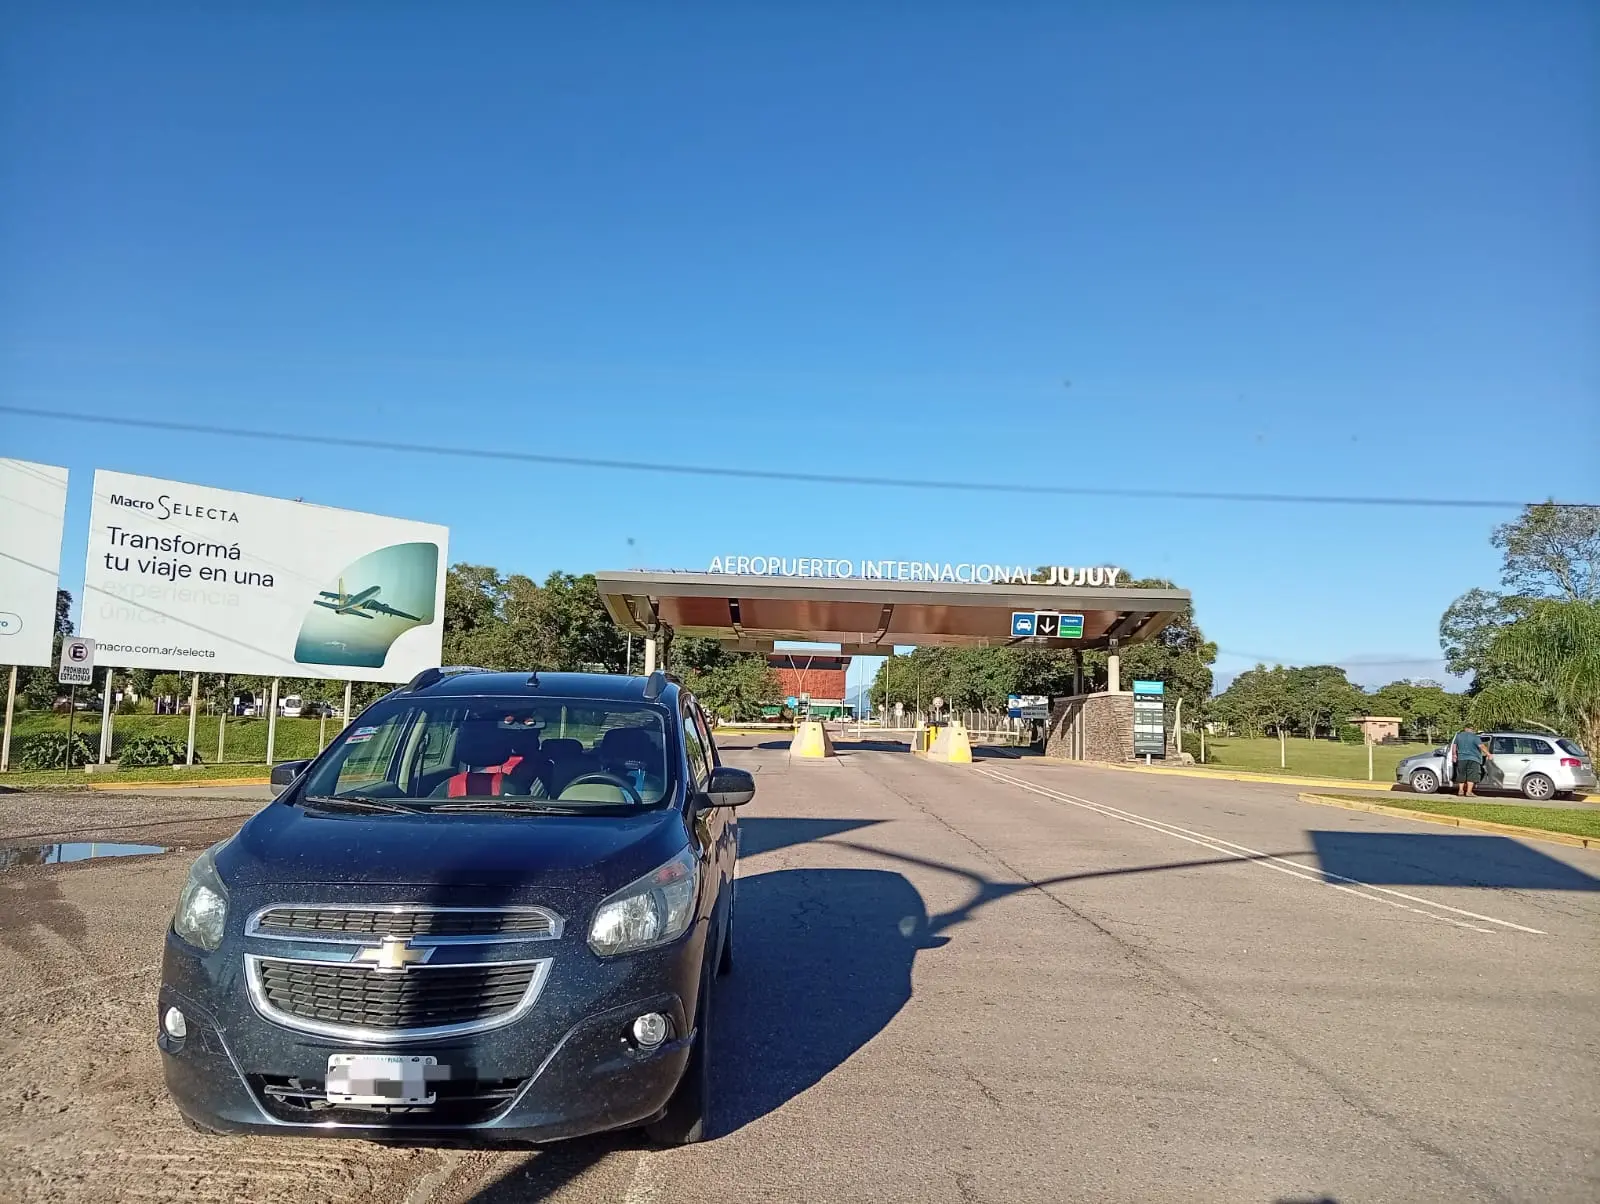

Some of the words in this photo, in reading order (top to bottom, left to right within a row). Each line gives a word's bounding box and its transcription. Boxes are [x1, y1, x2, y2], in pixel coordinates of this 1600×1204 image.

[110, 494, 155, 511] Macro
[157, 495, 239, 523] SELECTA
[107, 526, 241, 561] Transformá
[104, 552, 129, 572] tu
[138, 556, 192, 582] viaje
[199, 566, 227, 582] en
[234, 570, 274, 588] una
[708, 555, 853, 579] AEROPUERTO
[861, 559, 1039, 585] INTERNACIONAL
[1046, 566, 1120, 587] JUJUY
[102, 580, 240, 606] experiencia
[72, 645, 84, 658] E
[95, 643, 215, 658] macro.com.ar/selecta
[60, 672, 91, 682] ESTACIONAR
[63, 665, 90, 675] PROHIBIDO
